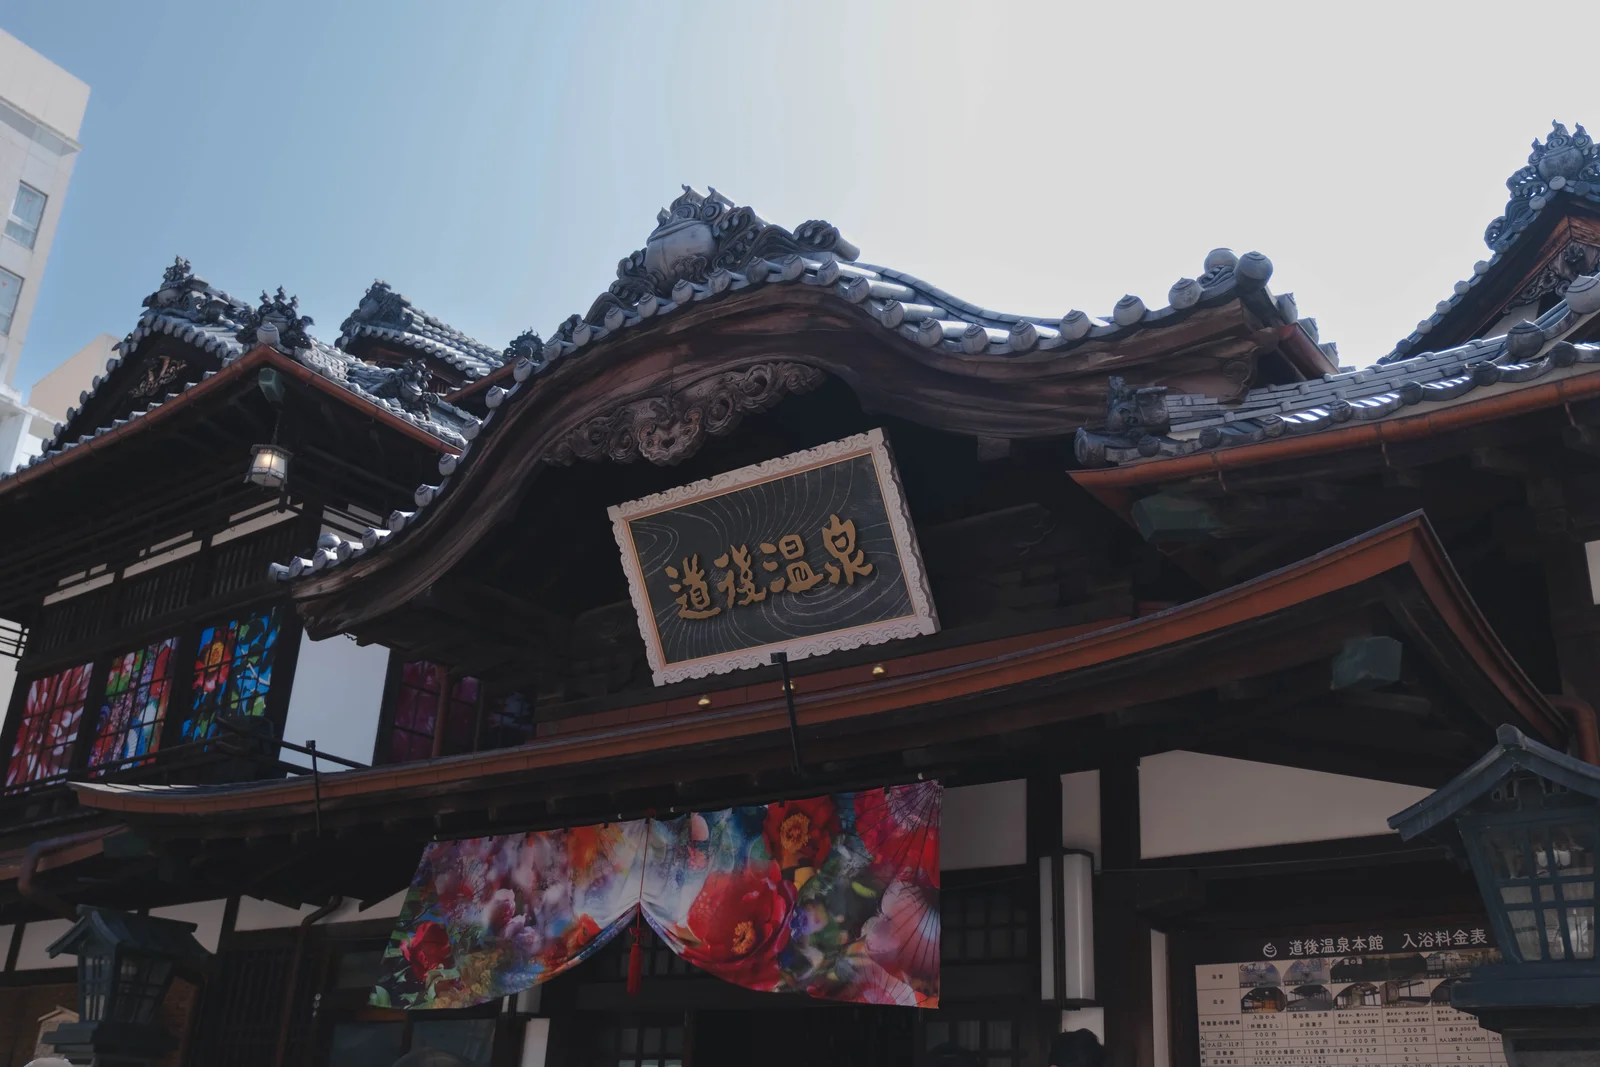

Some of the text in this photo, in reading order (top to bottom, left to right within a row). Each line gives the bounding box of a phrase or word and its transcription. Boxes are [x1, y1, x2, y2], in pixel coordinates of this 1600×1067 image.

[664, 513, 874, 621] 道後温泉
[1289, 928, 1487, 956] 道後温泉本館 入浴料金表
